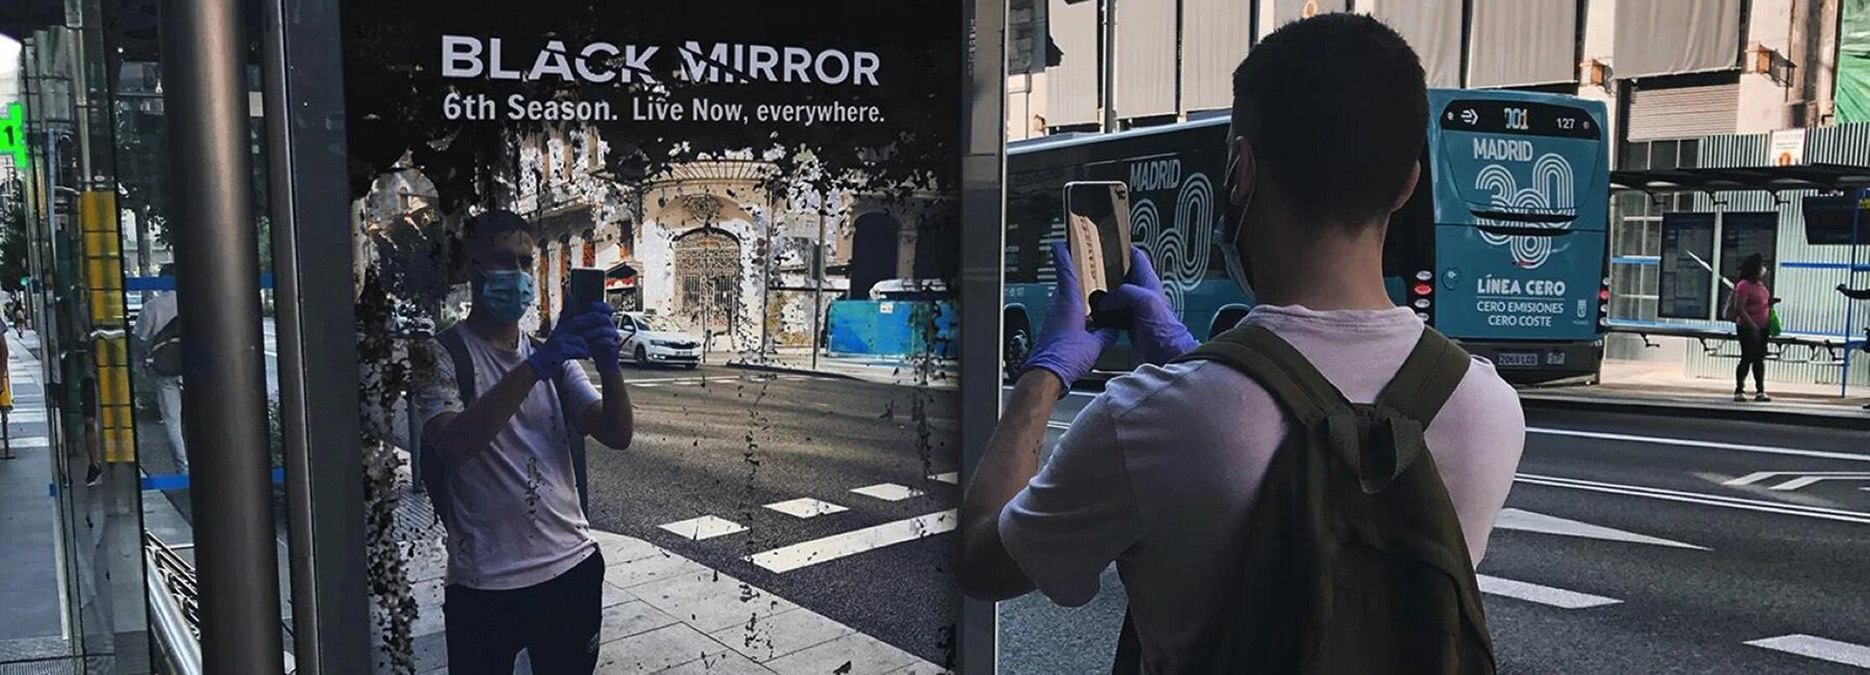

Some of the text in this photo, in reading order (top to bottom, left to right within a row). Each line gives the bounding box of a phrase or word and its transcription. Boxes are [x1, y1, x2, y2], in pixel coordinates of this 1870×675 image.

[441, 34, 880, 86] BLACK MIRROR
[443, 93, 885, 126] 6th Season. Live Now, everywhere.
[1556, 117, 1576, 129] 127
[1473, 138, 1533, 161] MADRID
[1130, 159, 1181, 191] MADRID
[1477, 274, 1566, 297] LÍNEA CERO
[1476, 301, 1564, 314] CERO EMISIONES
[1488, 315, 1552, 327] CERO COSTE
